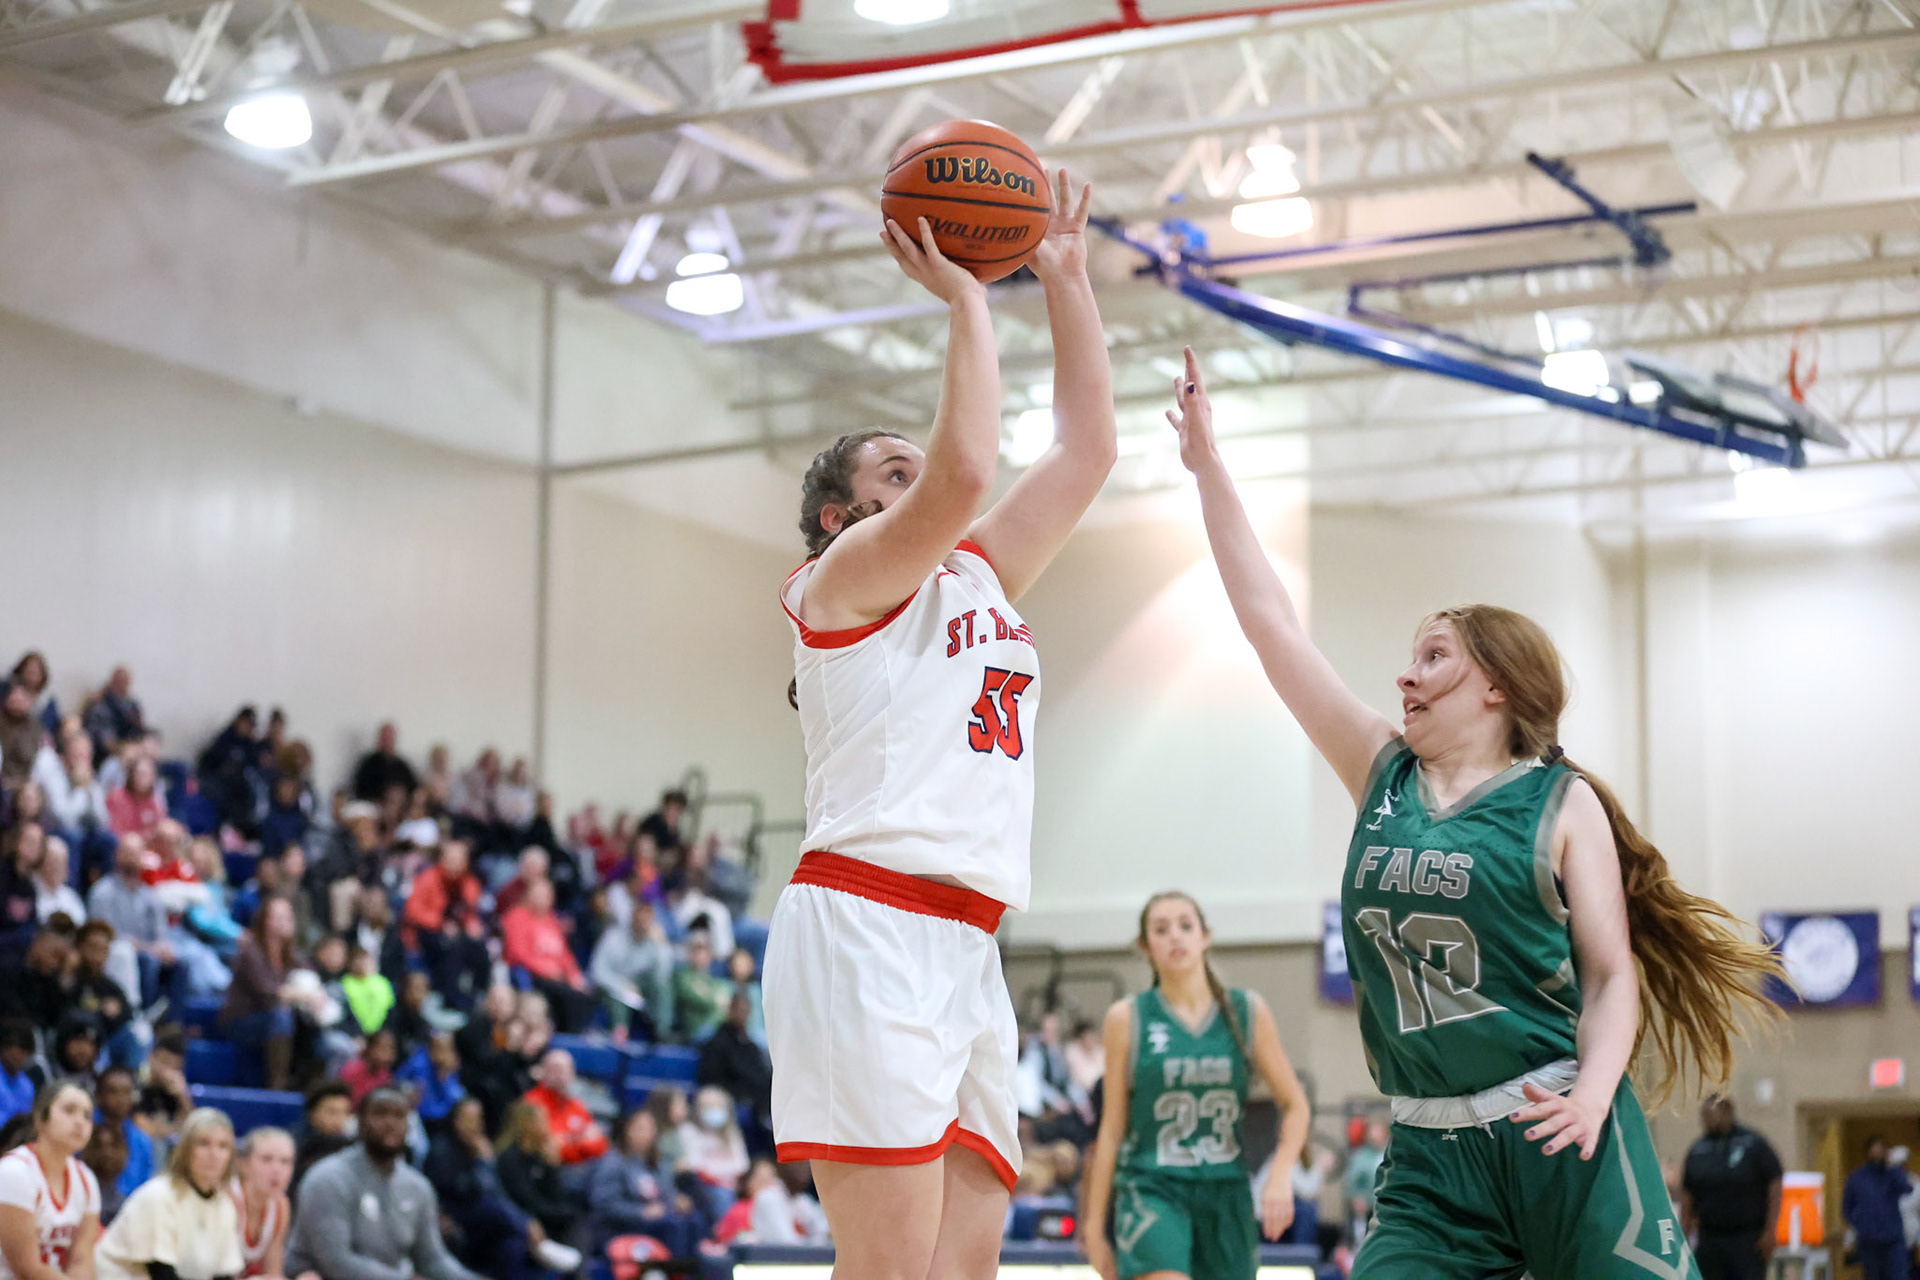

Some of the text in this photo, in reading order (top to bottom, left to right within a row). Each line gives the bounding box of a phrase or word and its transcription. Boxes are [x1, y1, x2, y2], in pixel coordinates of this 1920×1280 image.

[925, 157, 1035, 197] Wilson
[946, 609, 987, 658] ST.
[968, 666, 1035, 761] 55
[1354, 846, 1474, 899] FACS
[1355, 908, 1510, 1033] 12
[1154, 1088, 1241, 1166] 23
[1657, 1219, 1675, 1254] F
